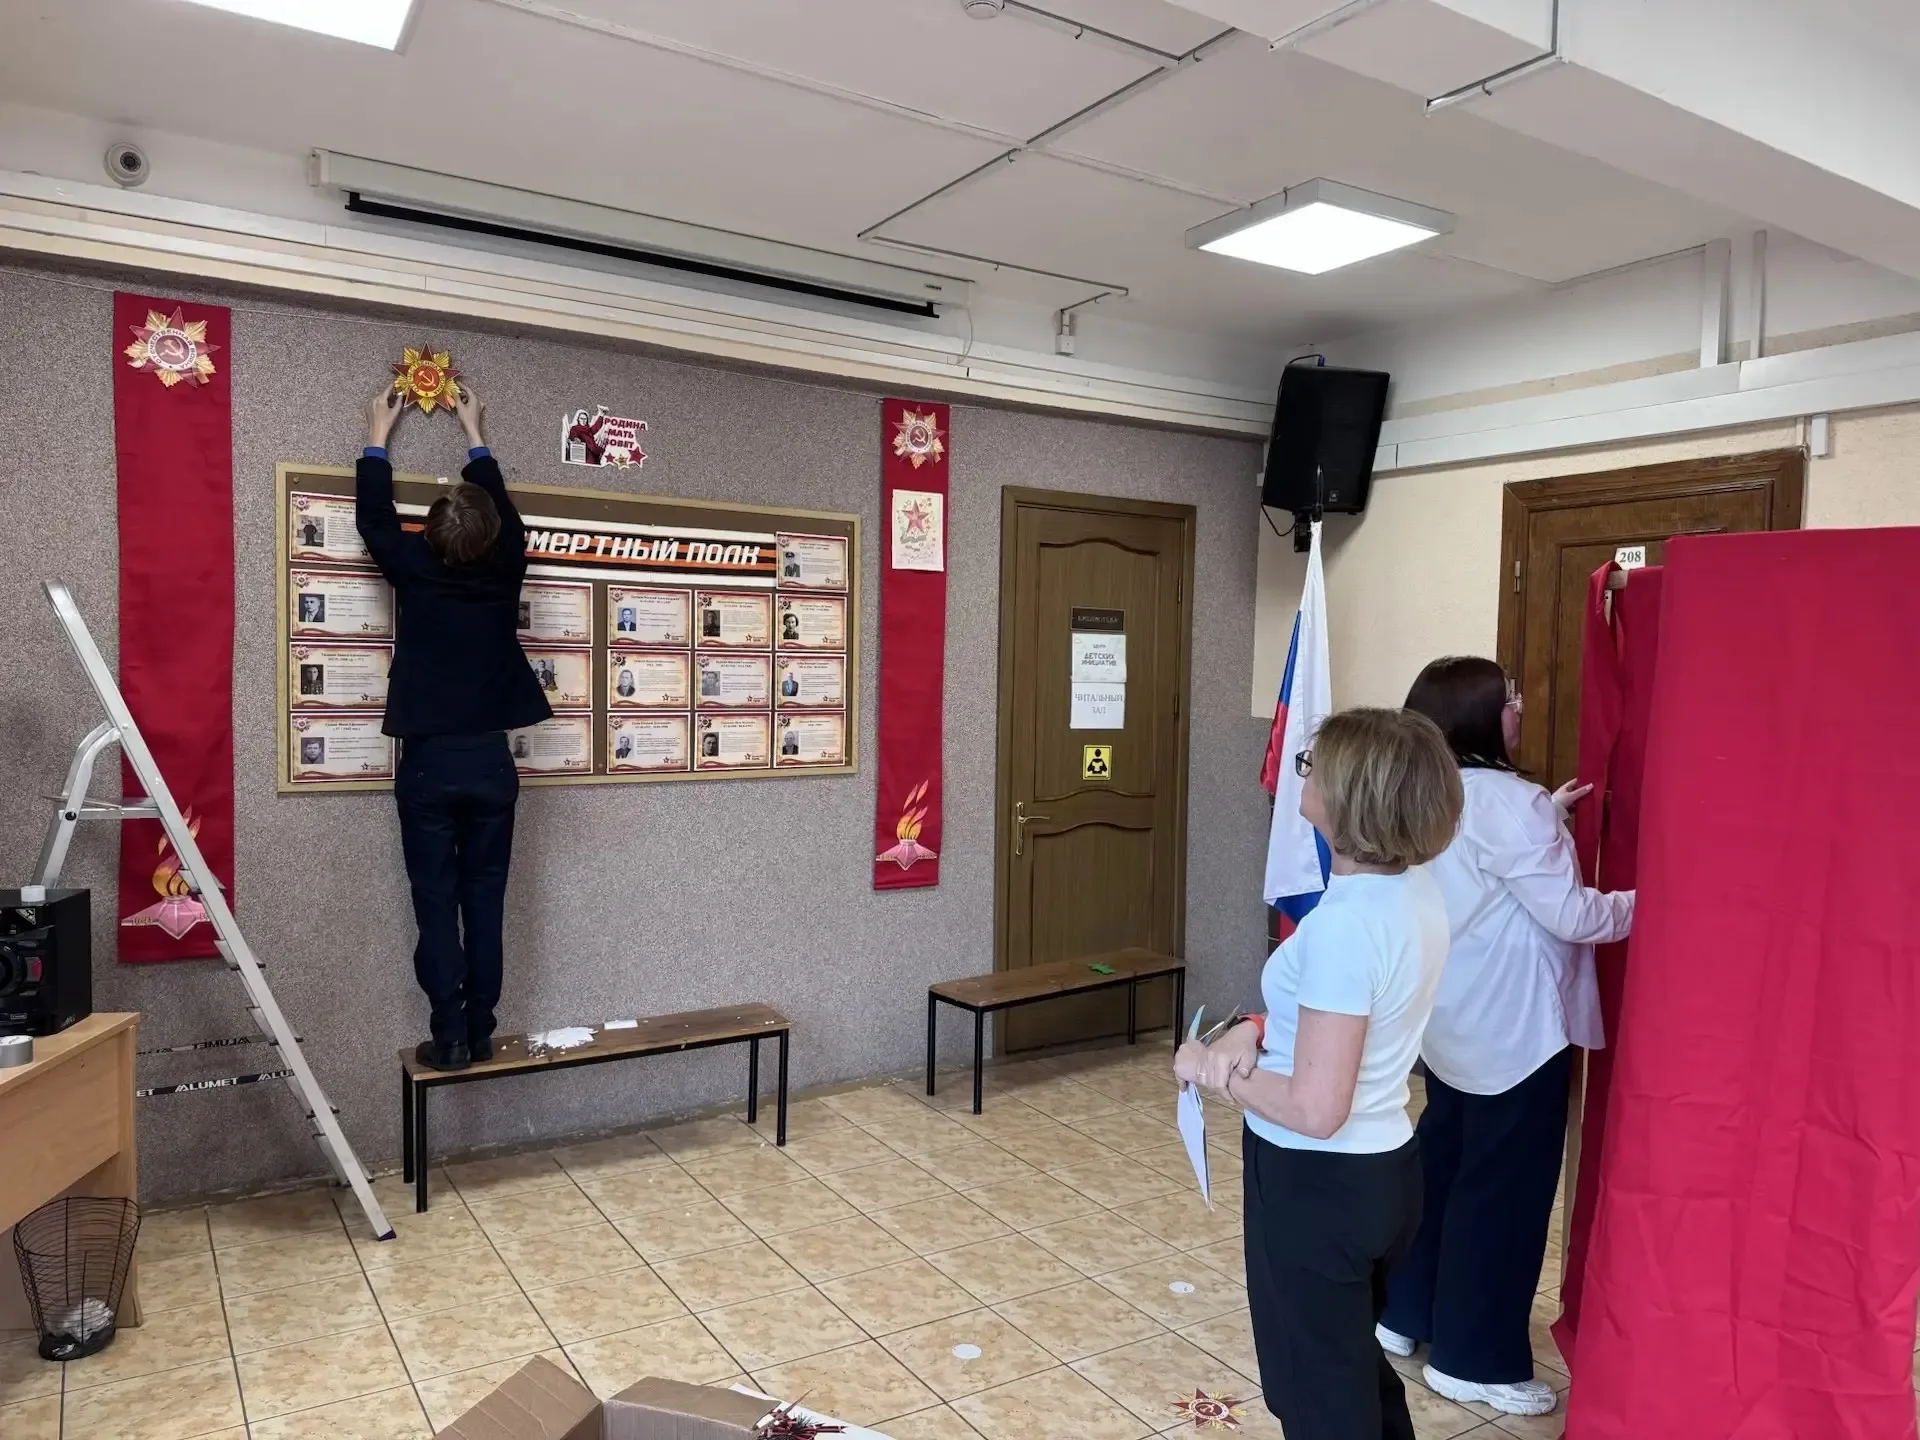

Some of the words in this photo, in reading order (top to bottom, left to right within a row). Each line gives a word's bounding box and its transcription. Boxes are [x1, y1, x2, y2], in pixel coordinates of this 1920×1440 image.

[604, 418, 647, 430] РОДИНА
[603, 438, 634, 449] ЗОВЕТ
[524, 530, 677, 561] МЕРТНЫЙ
[685, 543, 760, 565] ПОЛК
[1619, 551, 1642, 563] 208
[1075, 693, 1123, 702] ЧИТАЛЬНЫЙ
[1092, 706, 1106, 715] ЗАЛ
[174, 1077, 239, 1093] ALUMET
